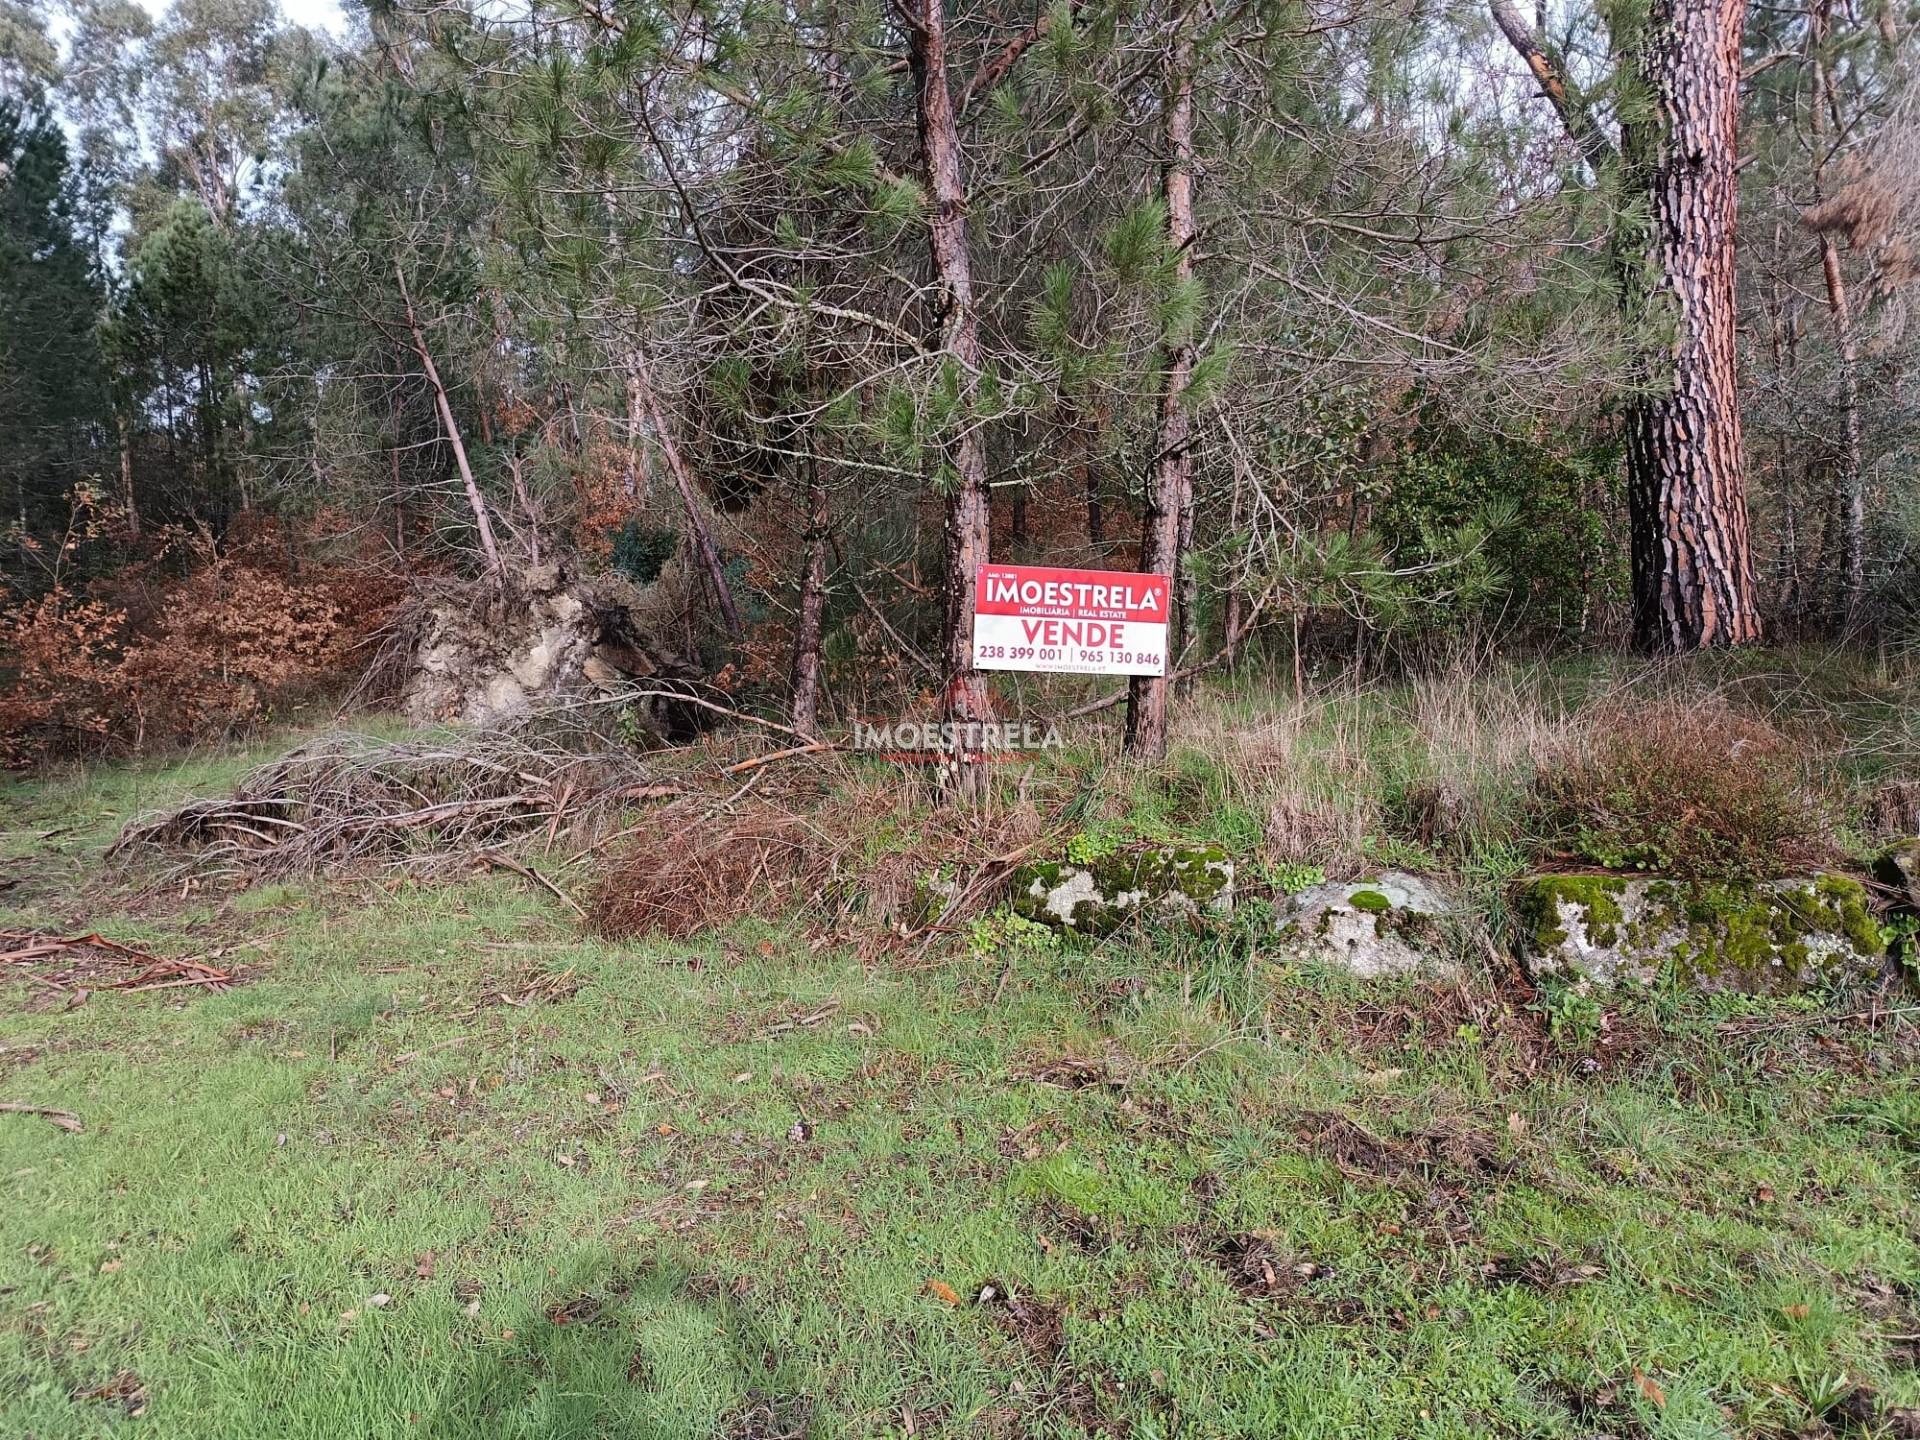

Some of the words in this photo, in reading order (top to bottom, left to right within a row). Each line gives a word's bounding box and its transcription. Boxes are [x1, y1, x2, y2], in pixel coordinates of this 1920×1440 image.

[1020, 606, 1070, 616] IMOBILIÁRIA
[1078, 609, 1097, 617] REAL
[1100, 610, 1127, 619] ESTATE
[1021, 619, 1124, 649] VENDE
[979, 645, 1005, 658] 238
[1009, 647, 1035, 660] 399
[1039, 648, 1062, 661] 001
[1079, 650, 1104, 662] 965
[1110, 651, 1132, 664] 130
[1136, 652, 1160, 665] 846
